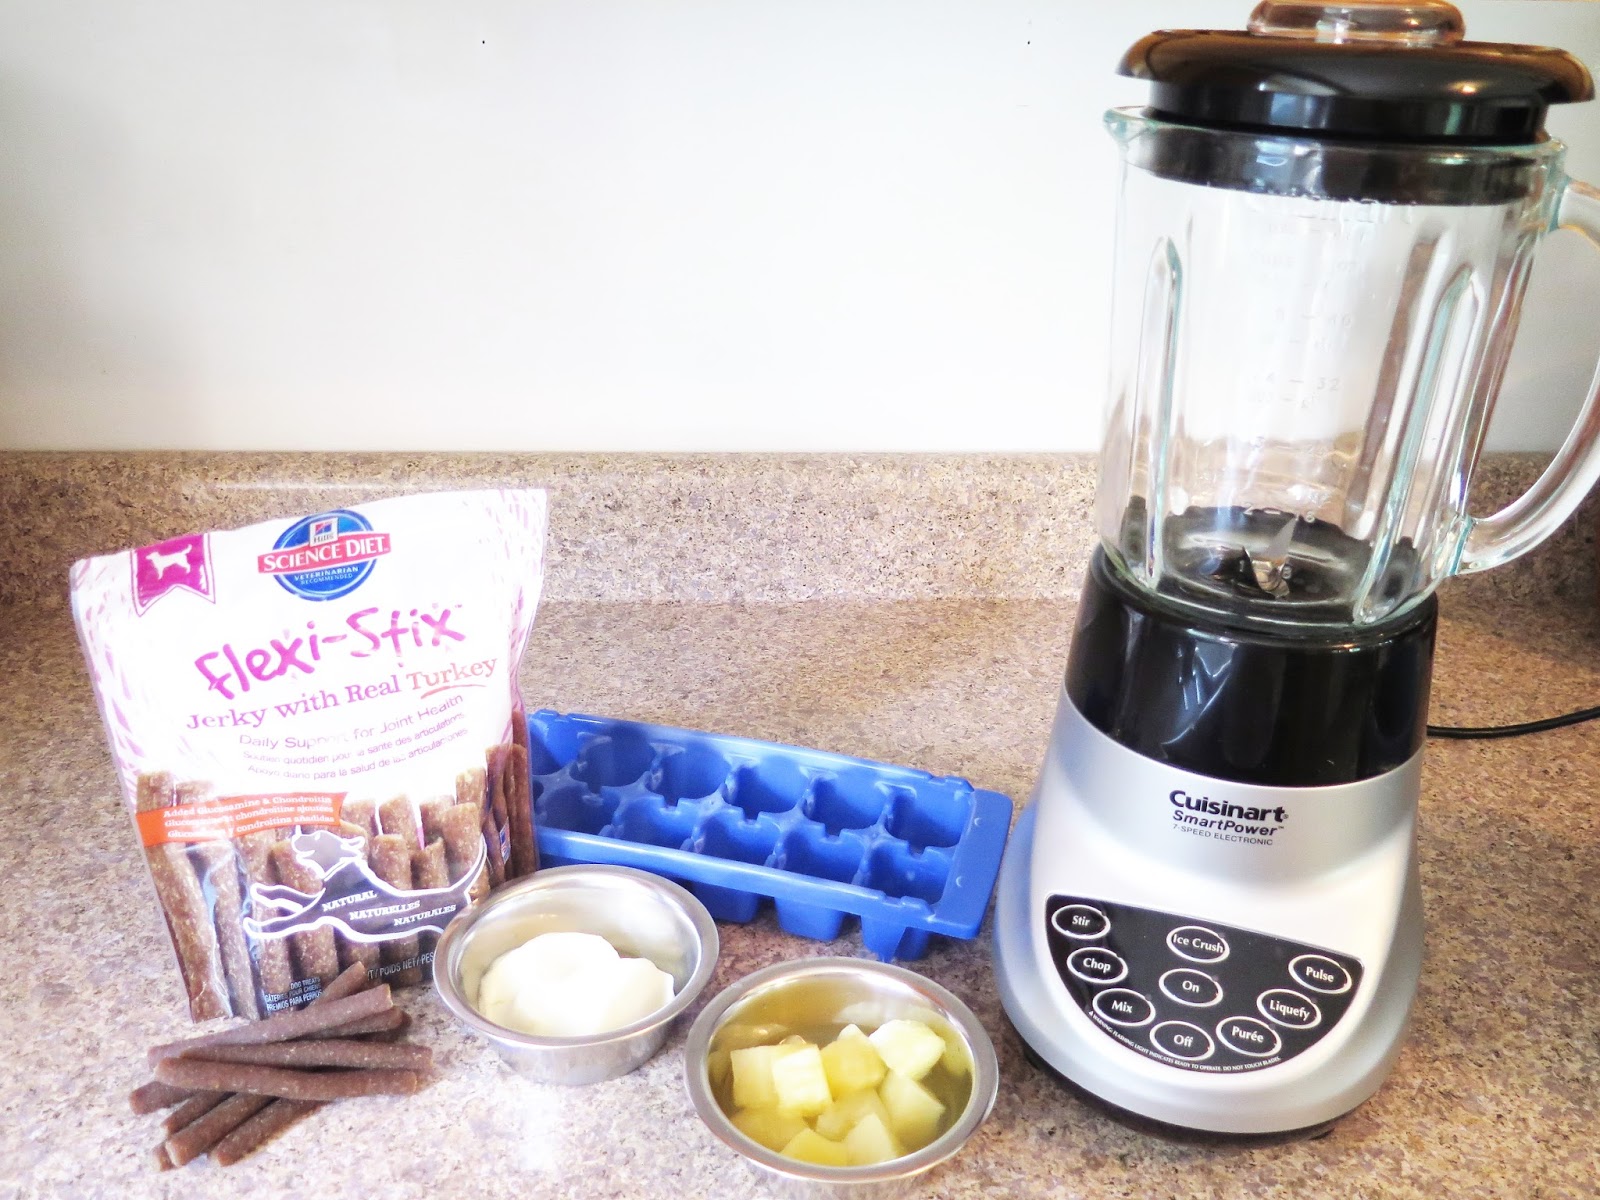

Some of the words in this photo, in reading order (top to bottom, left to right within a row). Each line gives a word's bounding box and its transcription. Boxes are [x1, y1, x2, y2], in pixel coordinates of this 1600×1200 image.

[263, 543, 342, 572] SCIENCE
[345, 536, 386, 558] DIET
[294, 566, 359, 582] VETERINARIAN
[301, 573, 353, 585] RECOMMENDED
[186, 708, 268, 729] Jerky
[274, 690, 340, 718] with
[344, 674, 402, 703] Real
[406, 658, 498, 690] Turkey
[239, 734, 279, 750] Daily
[353, 727, 375, 740] for
[380, 714, 414, 734] Joint
[417, 694, 464, 720] Health
[395, 735, 412, 747] des
[313, 770, 336, 781] para
[350, 761, 376, 775] salud
[378, 757, 391, 768] de
[408, 727, 469, 758] articulacones
[163, 807, 196, 819] Added
[272, 795, 333, 804] Chondroitin
[1169, 789, 1286, 823] Cuisinart
[1172, 809, 1279, 836] SmartPower
[1172, 823, 1212, 838] 7-SPEED
[1213, 832, 1273, 846] ELECTRONIC
[321, 889, 378, 912] NATURAL
[348, 900, 421, 921] NATURELLES
[393, 904, 457, 927] NATURALES
[1071, 914, 1091, 927] Stir
[1172, 933, 1190, 946] Ice
[1191, 937, 1225, 954] Crush
[379, 962, 401, 976] POIDS
[1082, 957, 1112, 974] Chop
[1305, 965, 1335, 983] Pulse
[1181, 980, 1200, 993] On
[289, 995, 303, 1007] PARA
[1111, 1000, 1133, 1014] Mix
[1269, 999, 1311, 1022] Liquefy
[1173, 1034, 1194, 1048] Off
[1231, 1025, 1264, 1044] Purée
[1112, 1031, 1135, 1048] FLASHING
[1134, 1043, 1150, 1054] LIGHT
[1149, 1051, 1175, 1064] INDICATES
[1174, 1059, 1191, 1068] READY
[1232, 1063, 1243, 1071] NOT
[1244, 1061, 1263, 1070] TOUCH
